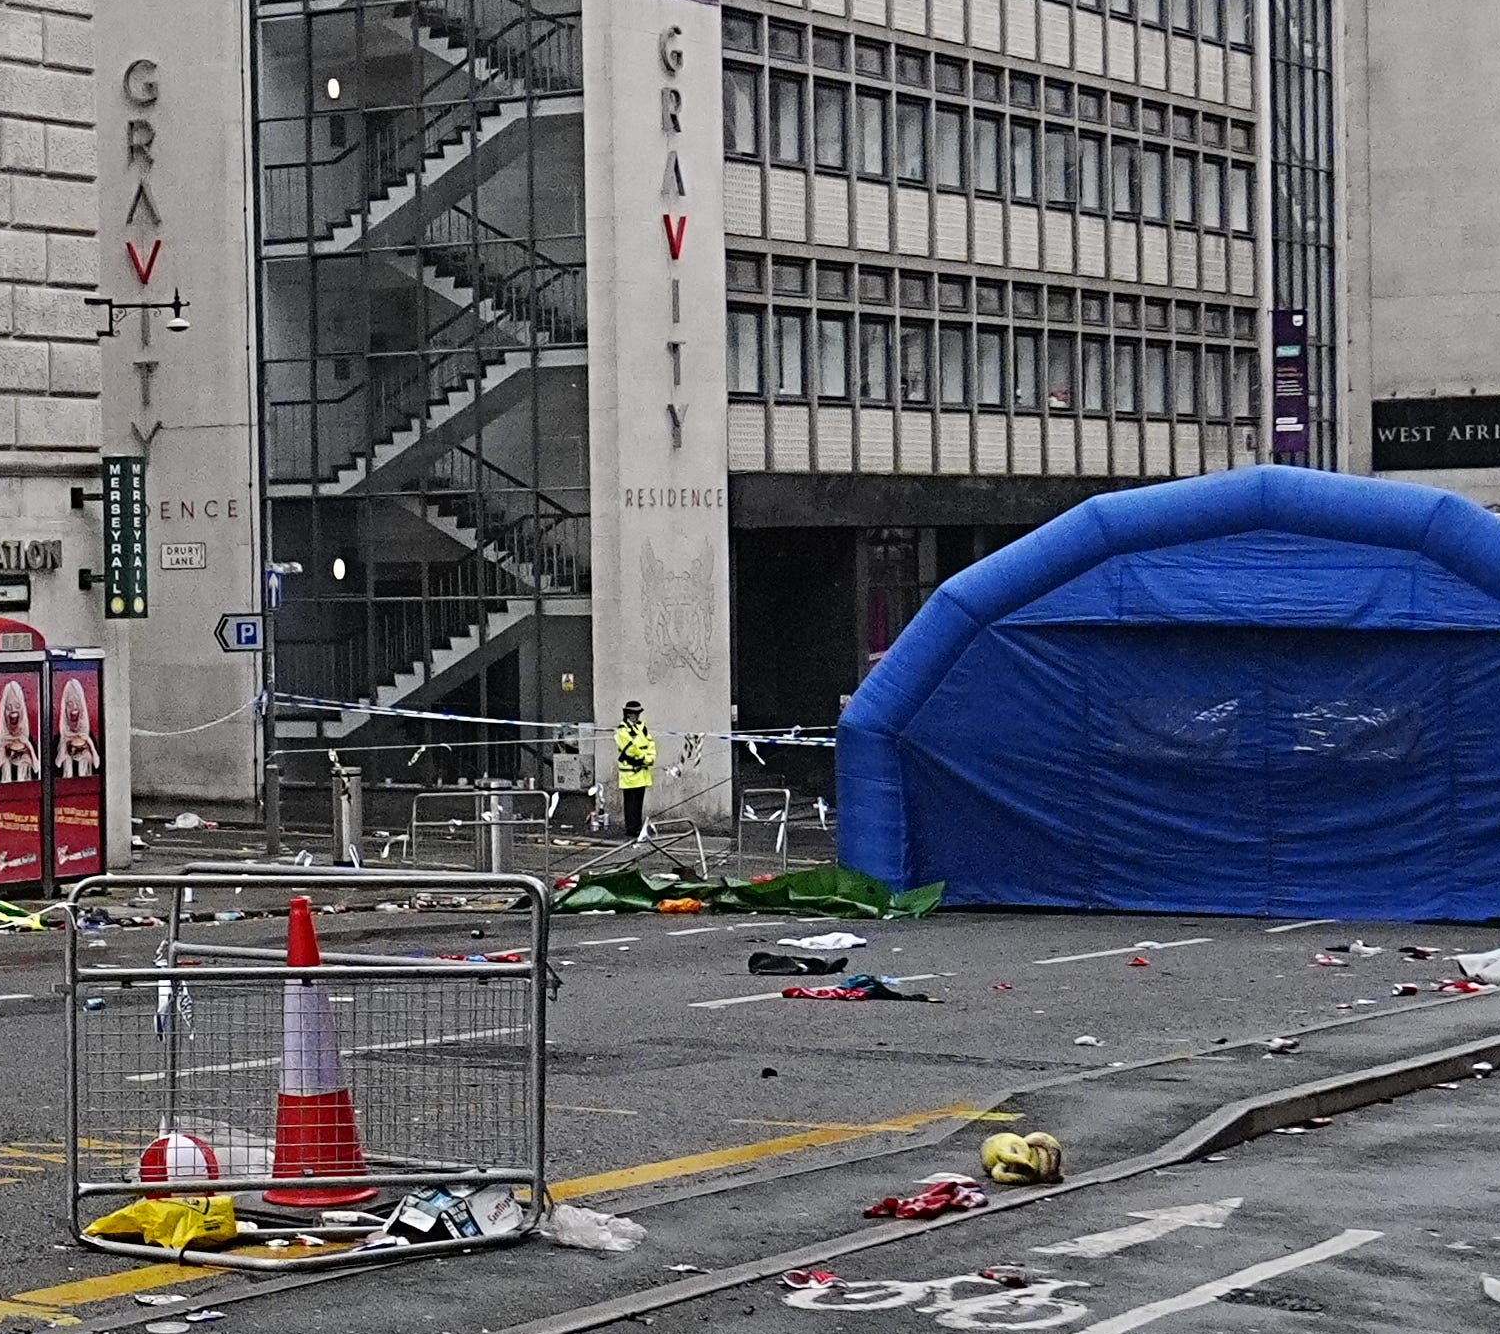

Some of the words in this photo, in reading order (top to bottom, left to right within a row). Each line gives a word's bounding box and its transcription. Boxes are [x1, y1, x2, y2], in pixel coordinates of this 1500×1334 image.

[658, 25, 689, 450] GRAVITY
[122, 58, 163, 465] GRAVITY
[1377, 426, 1435, 443] WEST
[625, 488, 724, 508] RESIDENCE
[108, 464, 123, 594] MERSEYRAIL
[131, 464, 143, 594] MERSEYRAIL
[166, 546, 199, 556] DRURY
[170, 556, 194, 566] LANE
[241, 624, 255, 643] P
